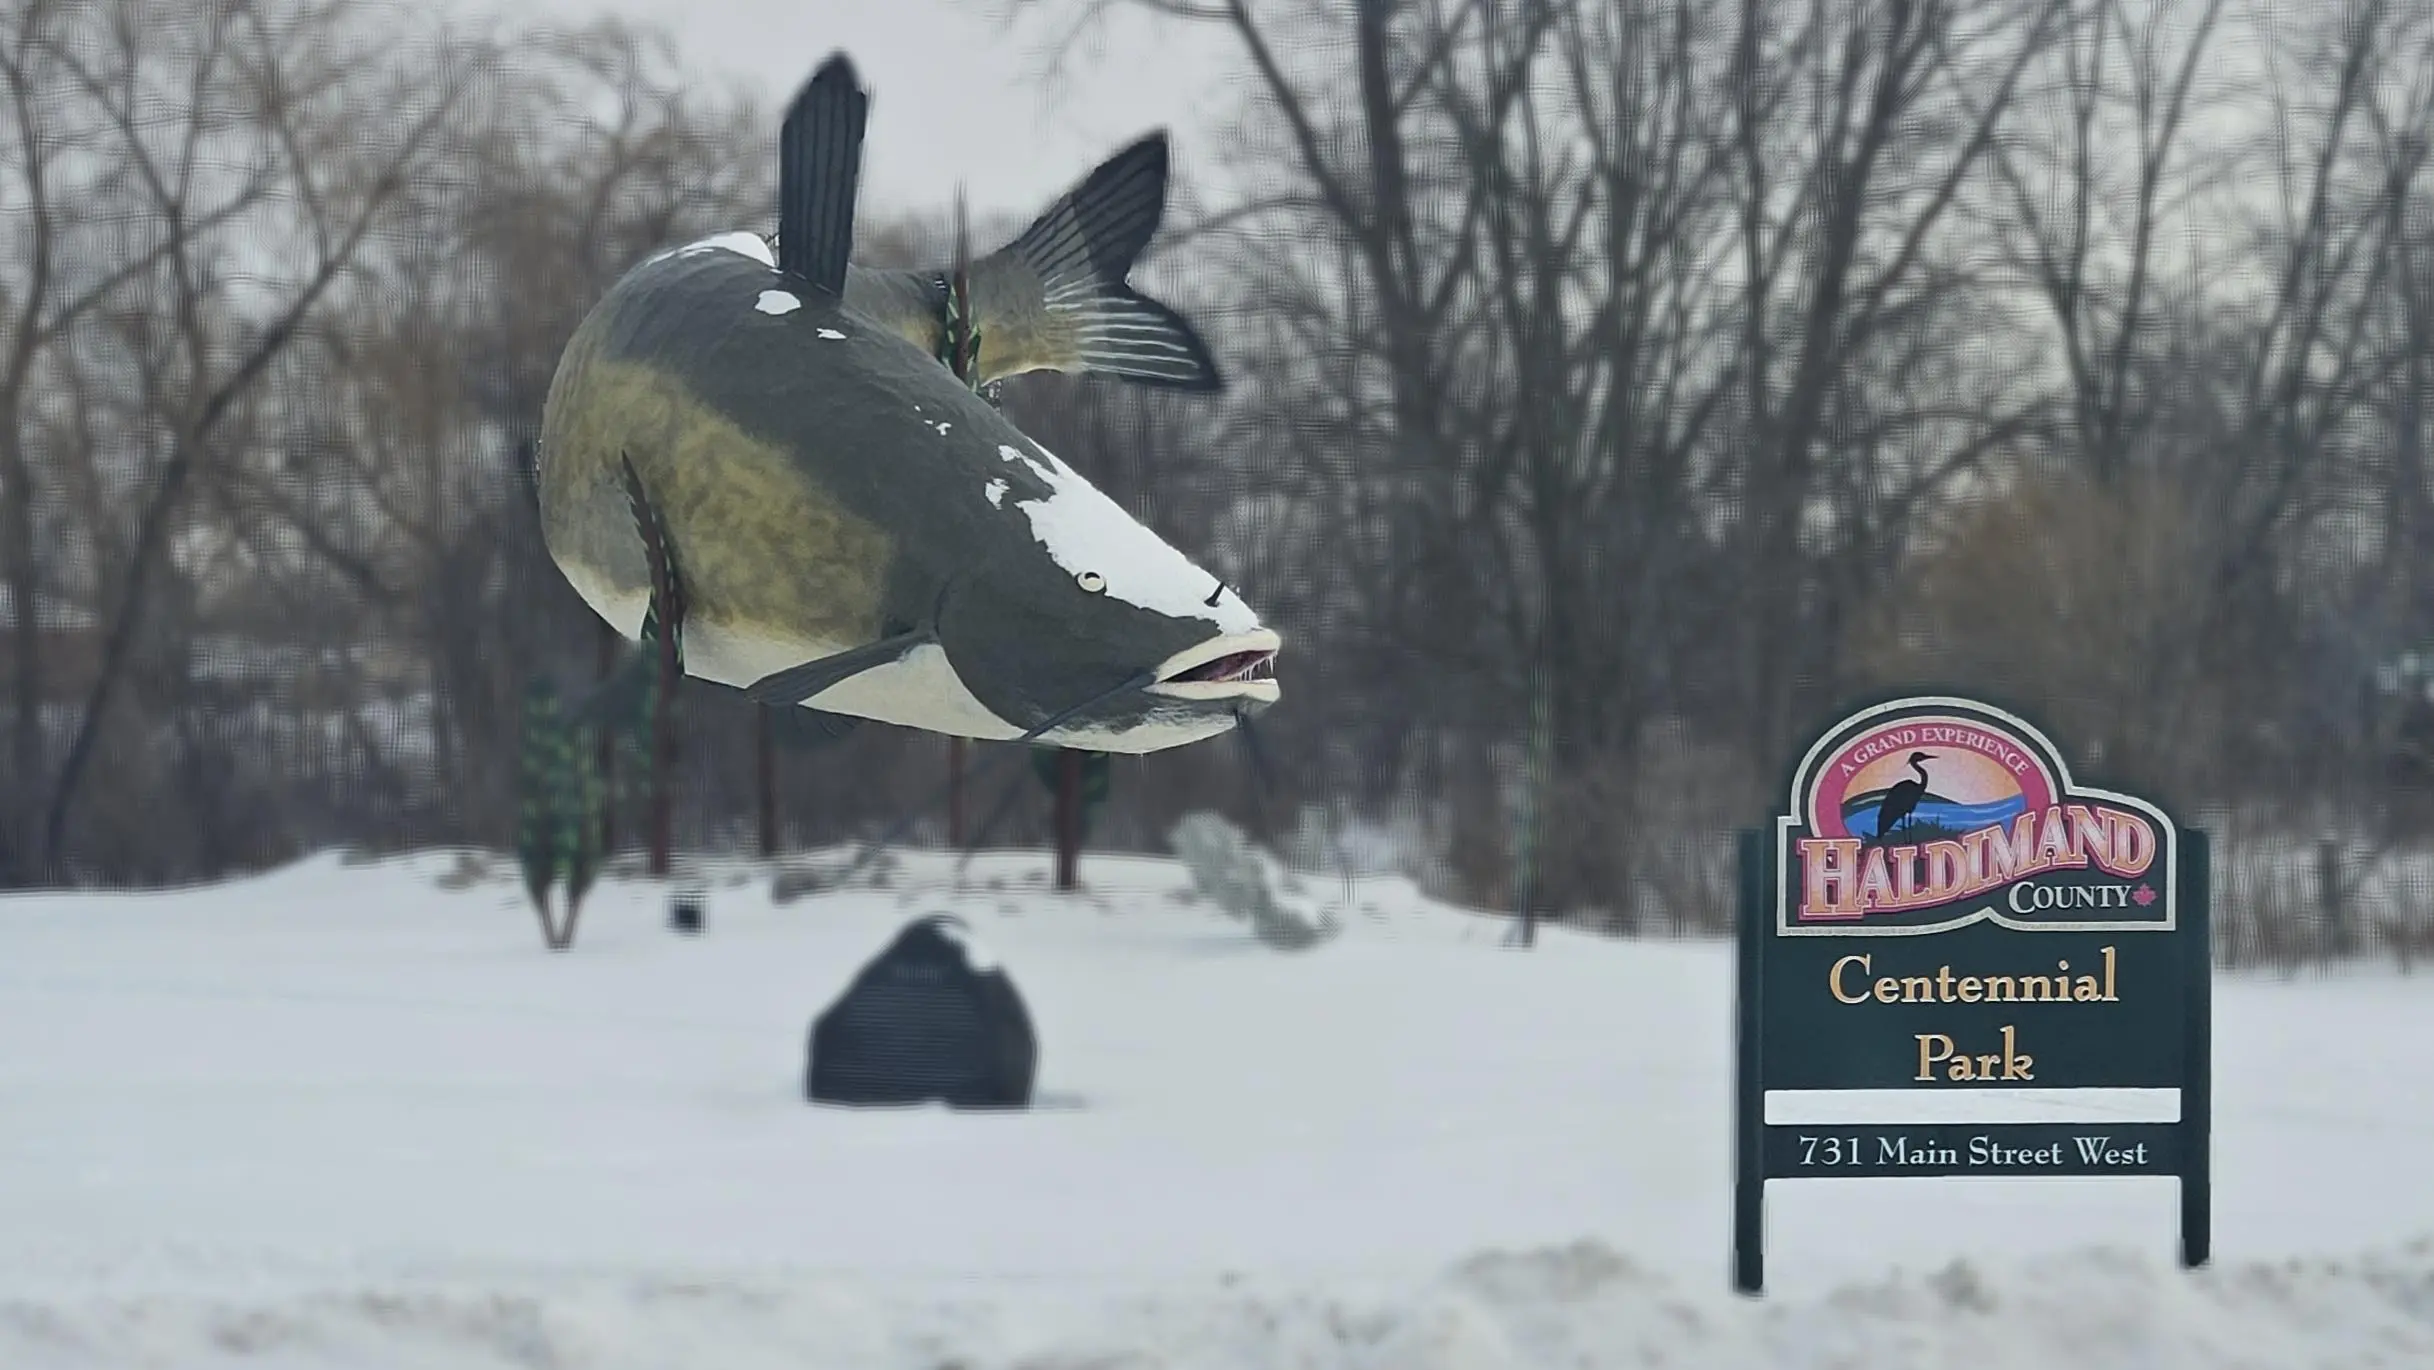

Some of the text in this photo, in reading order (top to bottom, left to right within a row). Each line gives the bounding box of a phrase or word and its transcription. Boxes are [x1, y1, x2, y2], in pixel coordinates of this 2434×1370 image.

[1840, 727, 2031, 778] A GRAND EXPERIENCE
[1799, 803, 2157, 918] HALDIMAND
[2008, 881, 2133, 914] COUNTY
[1828, 946, 2120, 1004] Centennial
[1913, 1025, 2036, 1082] Park
[1799, 1136, 2149, 1166] 731 Main Street West
